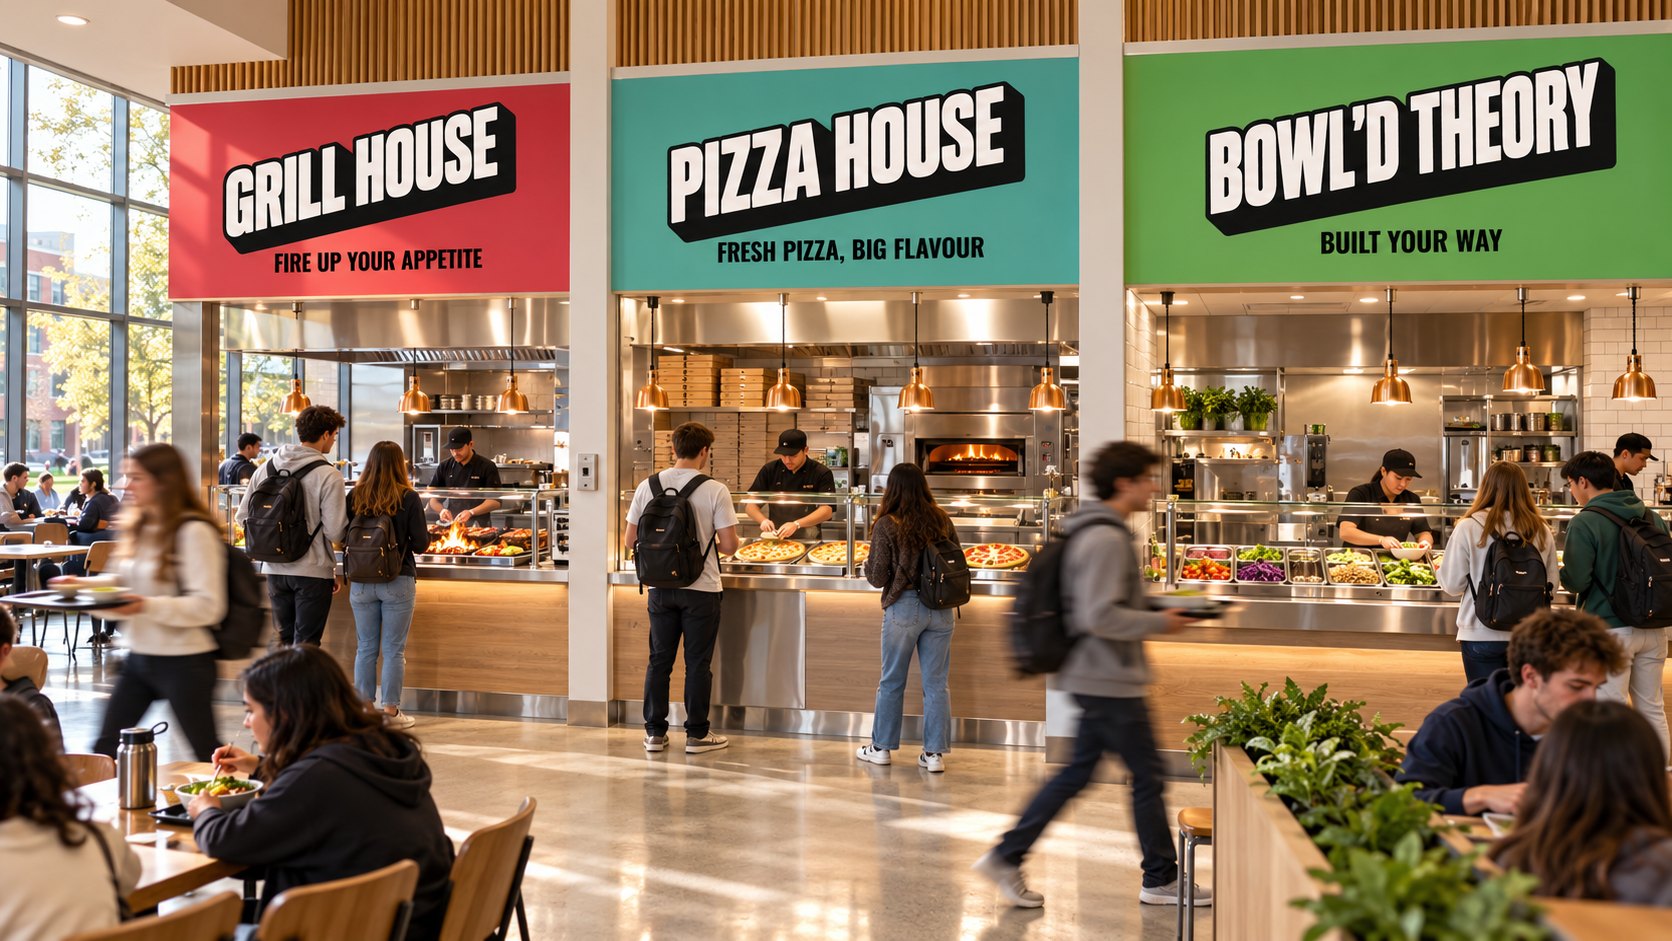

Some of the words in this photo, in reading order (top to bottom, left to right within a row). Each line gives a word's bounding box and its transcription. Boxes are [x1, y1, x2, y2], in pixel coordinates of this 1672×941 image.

[225, 145, 346, 238] GRILL
[355, 106, 498, 207] HOUSE
[671, 122, 821, 224] PIZZA
[835, 85, 1004, 192] HOUSE
[1209, 100, 1399, 215] BOWL'D
[1410, 61, 1599, 175] THEORY
[274, 252, 311, 273] FIRE
[317, 252, 342, 273] UP
[347, 250, 395, 272] YOUR
[401, 248, 483, 270] APPETITE
[717, 240, 776, 264] FRESH
[783, 239, 845, 264] PIZZA,
[852, 238, 887, 261] BIG
[894, 236, 985, 260] FLAVOUR
[1320, 230, 1381, 255] BUILT
[1387, 229, 1448, 254] YOUR
[1455, 228, 1503, 253] WAY
